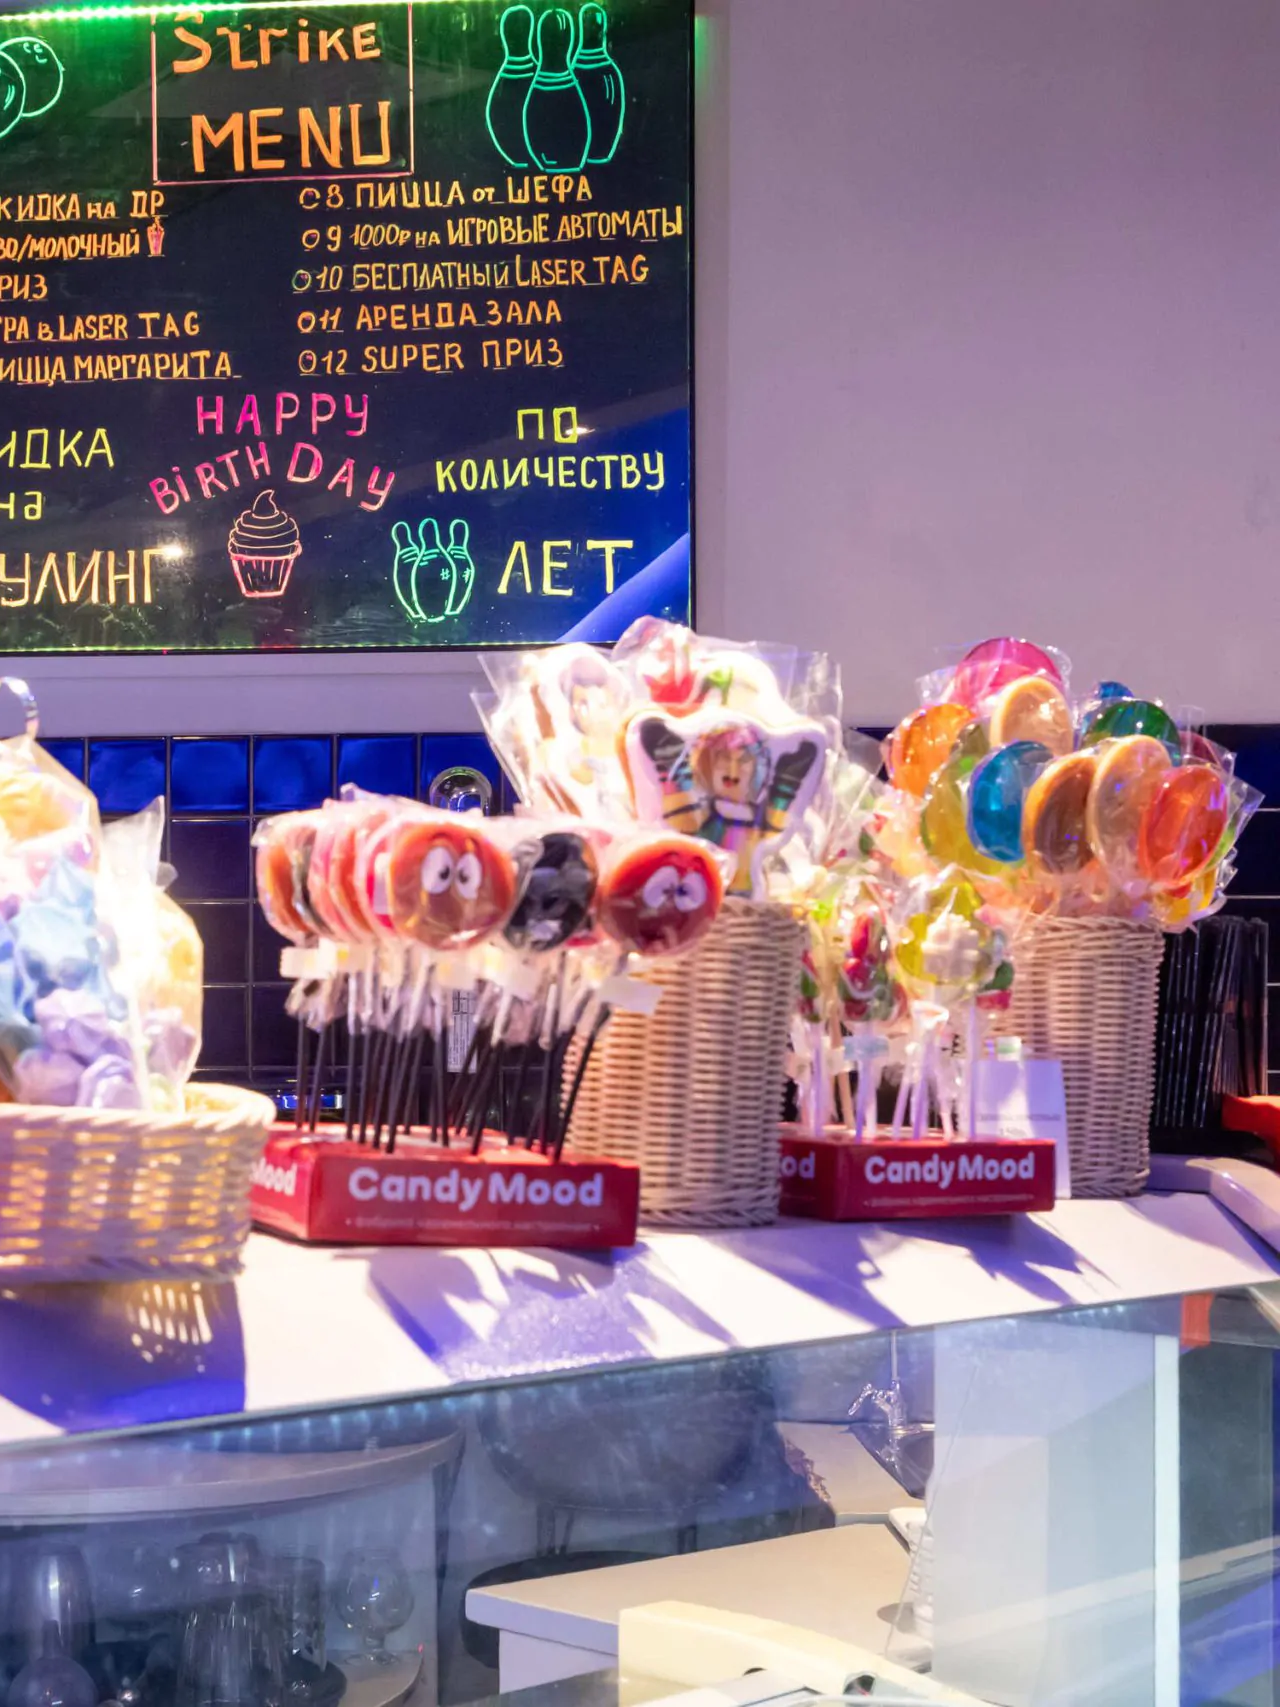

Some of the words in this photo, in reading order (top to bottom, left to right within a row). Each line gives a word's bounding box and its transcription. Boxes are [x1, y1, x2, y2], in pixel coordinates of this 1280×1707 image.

[191, 101, 391, 172] MENU
[130, 190, 165, 218] ДР
[356, 180, 465, 208] ПИЦЦА
[507, 174, 593, 203] ШЕФА
[447, 213, 550, 246] ИГРОВЫЕ
[557, 205, 683, 240] АВТОМАТЫ
[352, 260, 510, 291] БЕСПЛАТНЫЙ
[593, 254, 650, 285] TAG
[58, 313, 129, 341] LASER
[138, 311, 200, 338] TAG
[356, 301, 477, 331] АРЕНДА
[486, 299, 563, 327] ЗАЛА
[73, 350, 233, 380] МАРГАРИТА
[361, 342, 465, 374] SUPER
[481, 337, 564, 370] ПРИЗ
[196, 392, 369, 436] HAPPY
[516, 406, 579, 443] ПО
[286, 442, 396, 512] DAY
[436, 450, 665, 493] КОЛИЧЕСТВУ
[497, 539, 634, 596] ЛЕТ
[864, 1153, 955, 1189] Candy
[958, 1151, 1035, 1180] Mood
[348, 1167, 483, 1212] Candy
[488, 1172, 604, 1206] Mood
